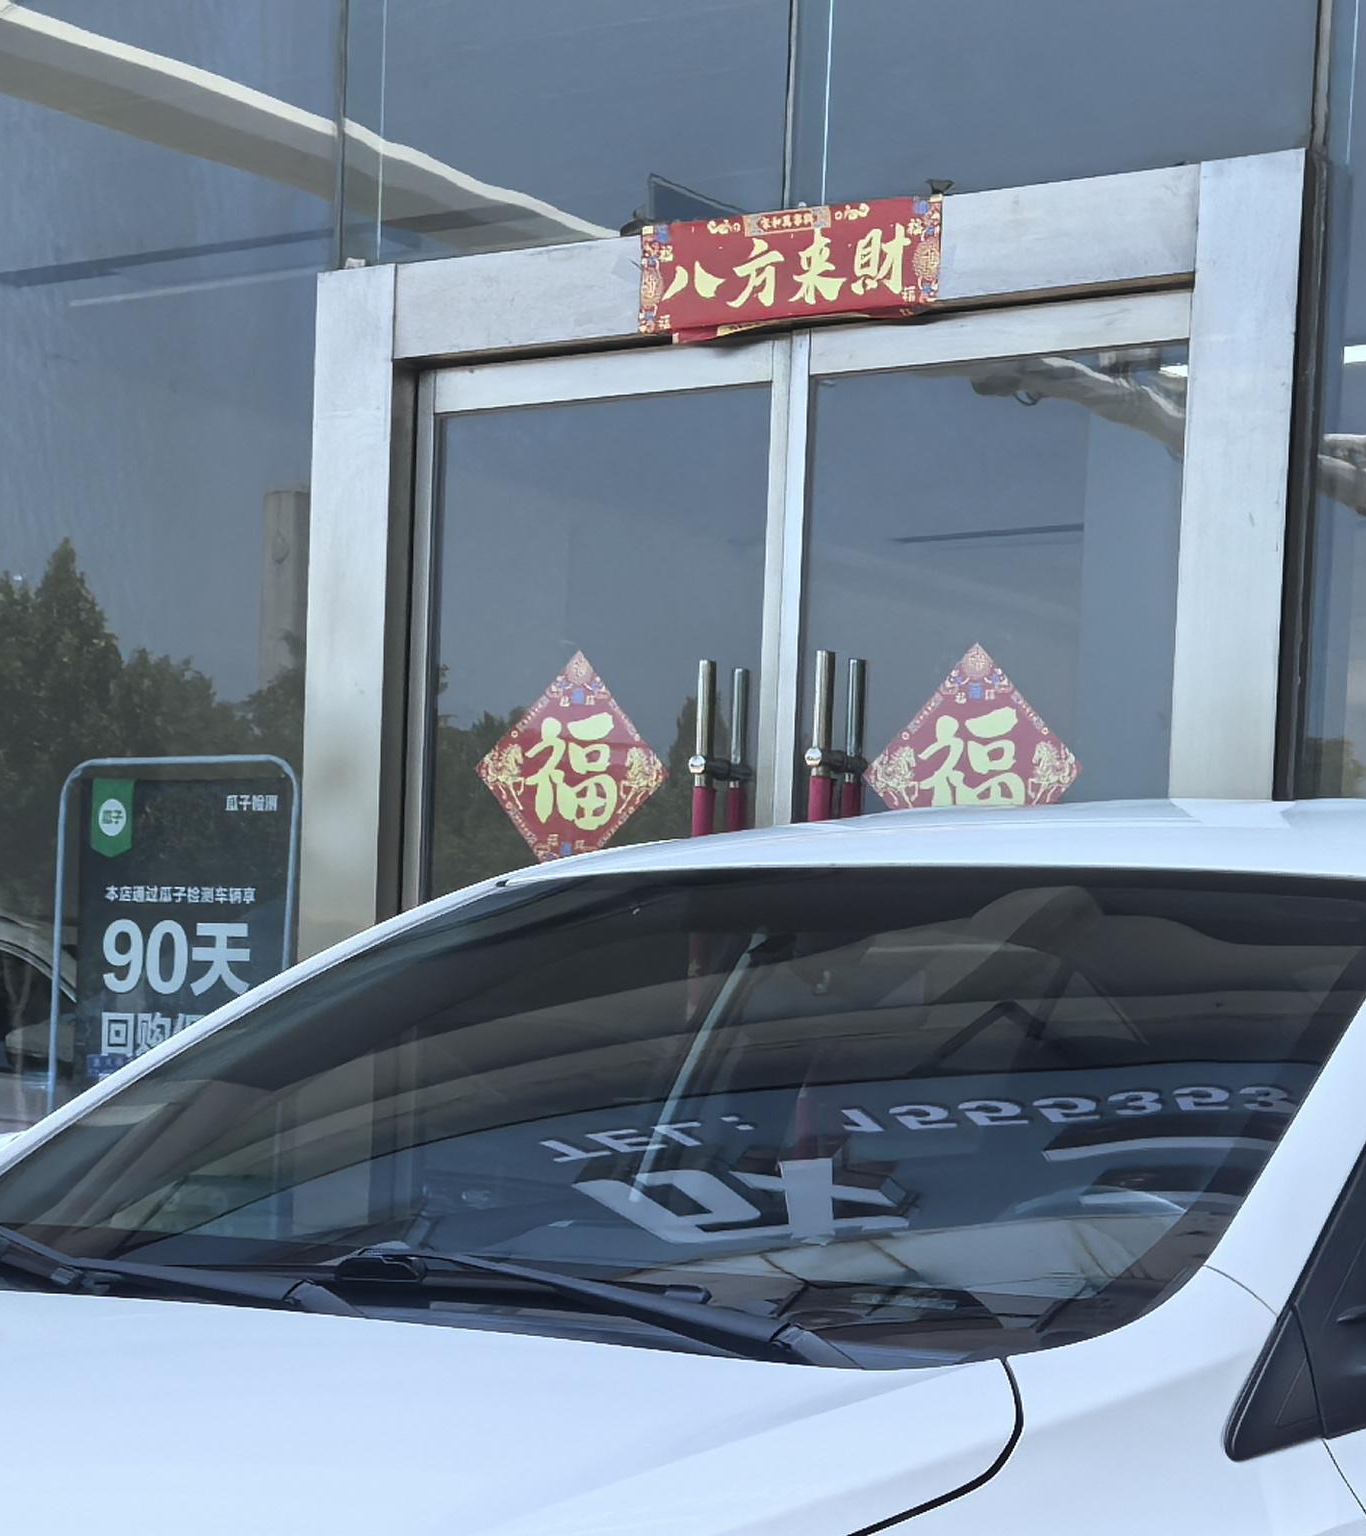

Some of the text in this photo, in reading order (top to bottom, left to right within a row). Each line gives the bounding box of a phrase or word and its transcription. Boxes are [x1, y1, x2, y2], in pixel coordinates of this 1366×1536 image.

[524, 711, 619, 832] 福
[917, 705, 1026, 808] 福
[102, 918, 251, 998] 90天
